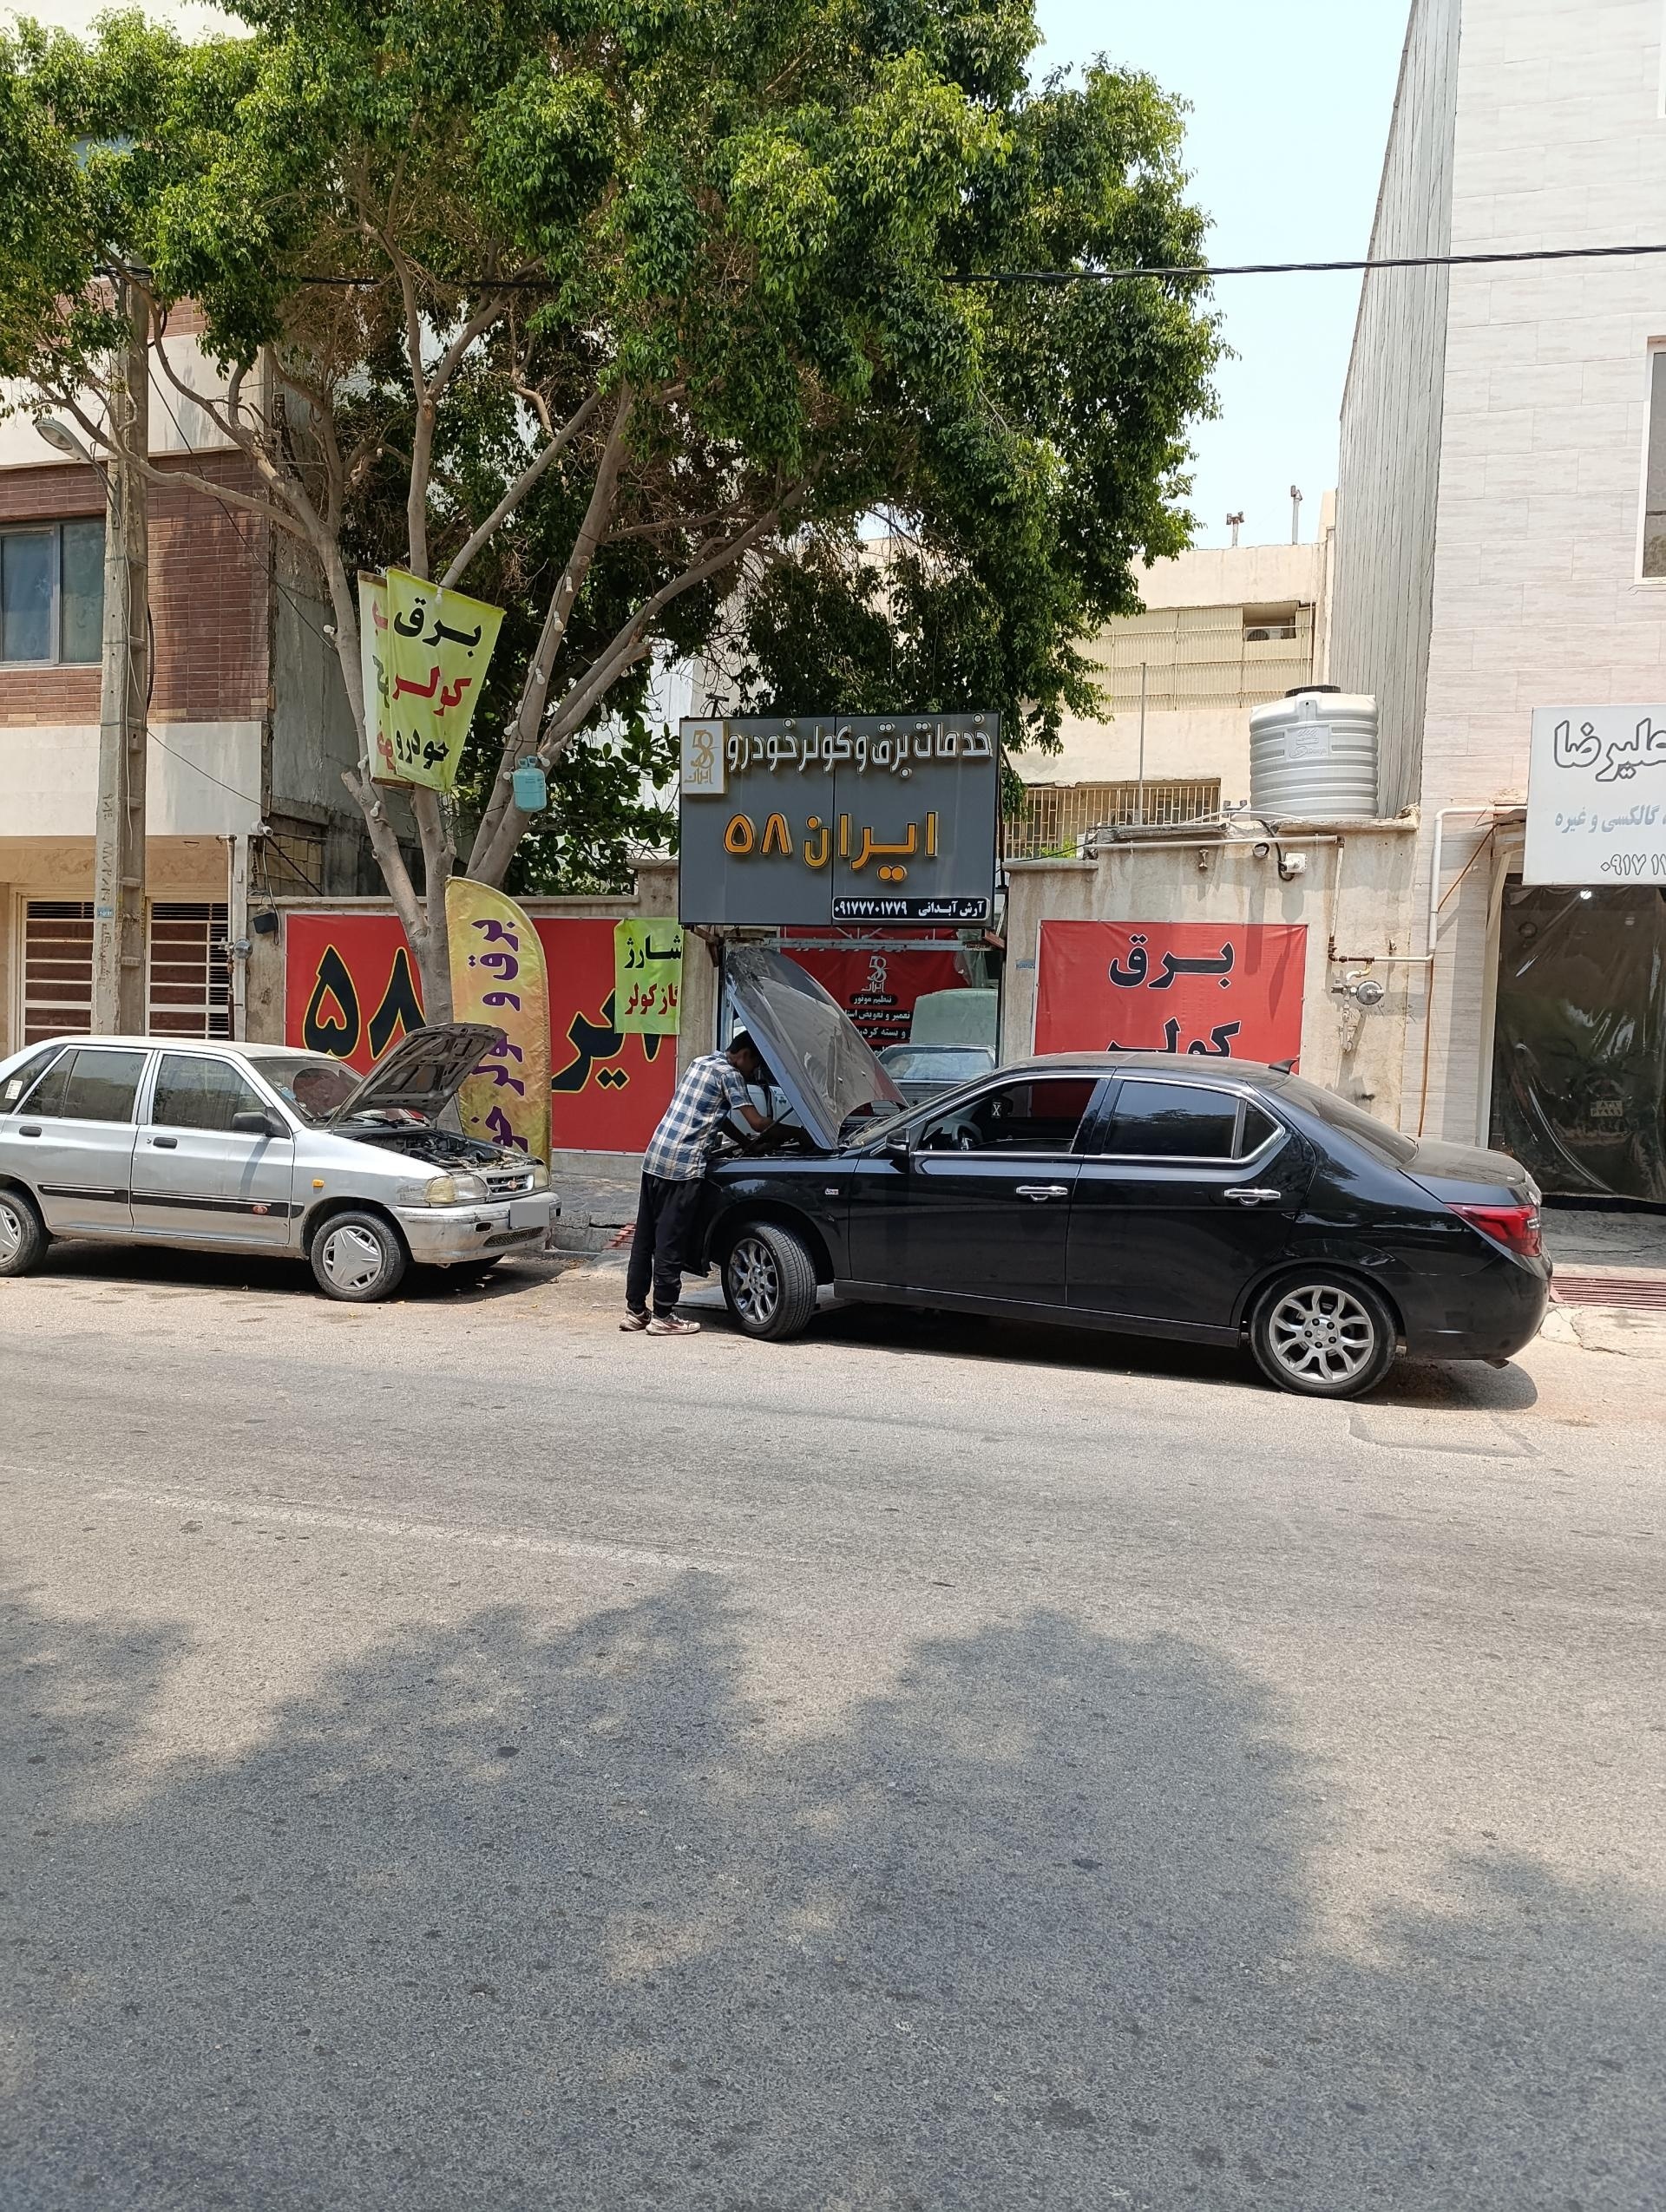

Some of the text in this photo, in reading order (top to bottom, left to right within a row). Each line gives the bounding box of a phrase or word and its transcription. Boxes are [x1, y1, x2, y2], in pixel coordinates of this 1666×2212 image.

[393, 597, 482, 658] برق
[392, 665, 473, 717] کولر
[726, 717, 799, 773] خودرو
[797, 723, 852, 774] کولر
[871, 721, 909, 778] برق
[913, 713, 994, 759] خدمات
[1555, 806, 1586, 834] غیره
[1588, 815, 1598, 833] و
[724, 811, 939, 882] ایران ۵۸
[835, 900, 984, 917] آرش آبدانی ۰۹۱۷۷۷۰۱۷۷۹
[469, 918, 520, 981] برق
[625, 934, 682, 969] شارژ
[1108, 933, 1236, 990] برق
[303, 944, 427, 1060] ۵۸
[624, 982, 658, 1015] کولر
